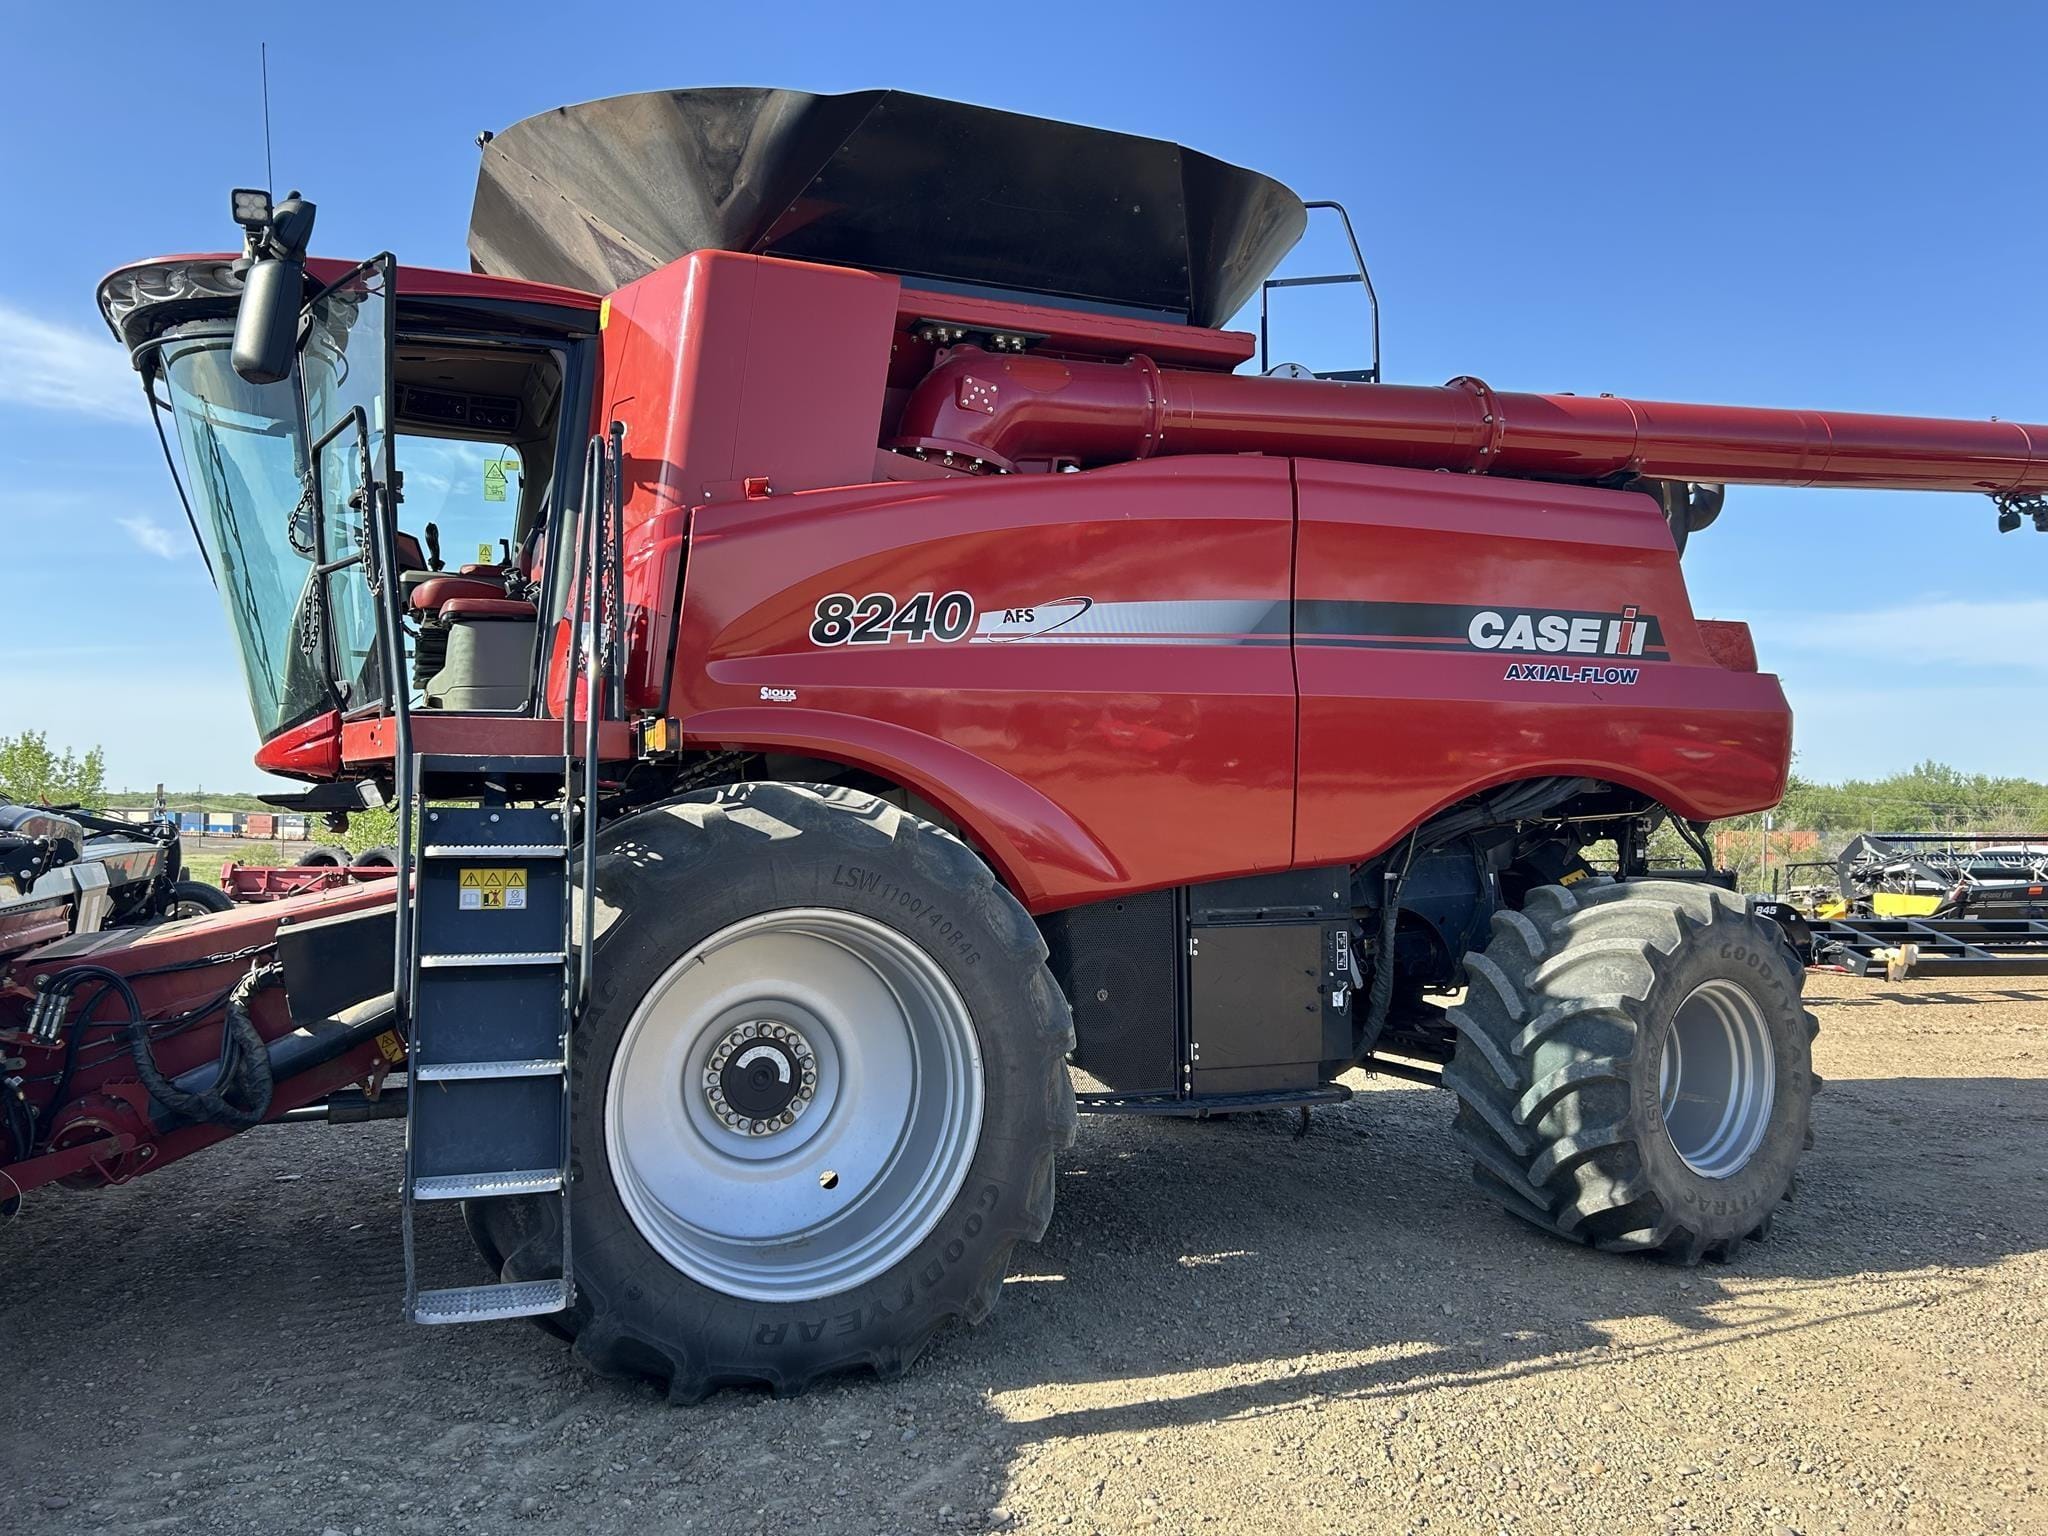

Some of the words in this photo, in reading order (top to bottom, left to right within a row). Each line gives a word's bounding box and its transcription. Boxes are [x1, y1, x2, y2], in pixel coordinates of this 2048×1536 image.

[809, 590, 975, 647] 8240
[1003, 608, 1035, 624] AFS
[1468, 611, 1601, 653] CASE
[1504, 663, 1640, 685] AXIAL-FLOW
[831, 863, 882, 893] LSW
[881, 883, 981, 966] 1100/40R46
[1719, 942, 1803, 1095] GOODYEAR
[754, 1183, 1001, 1346] GOODYEAR
